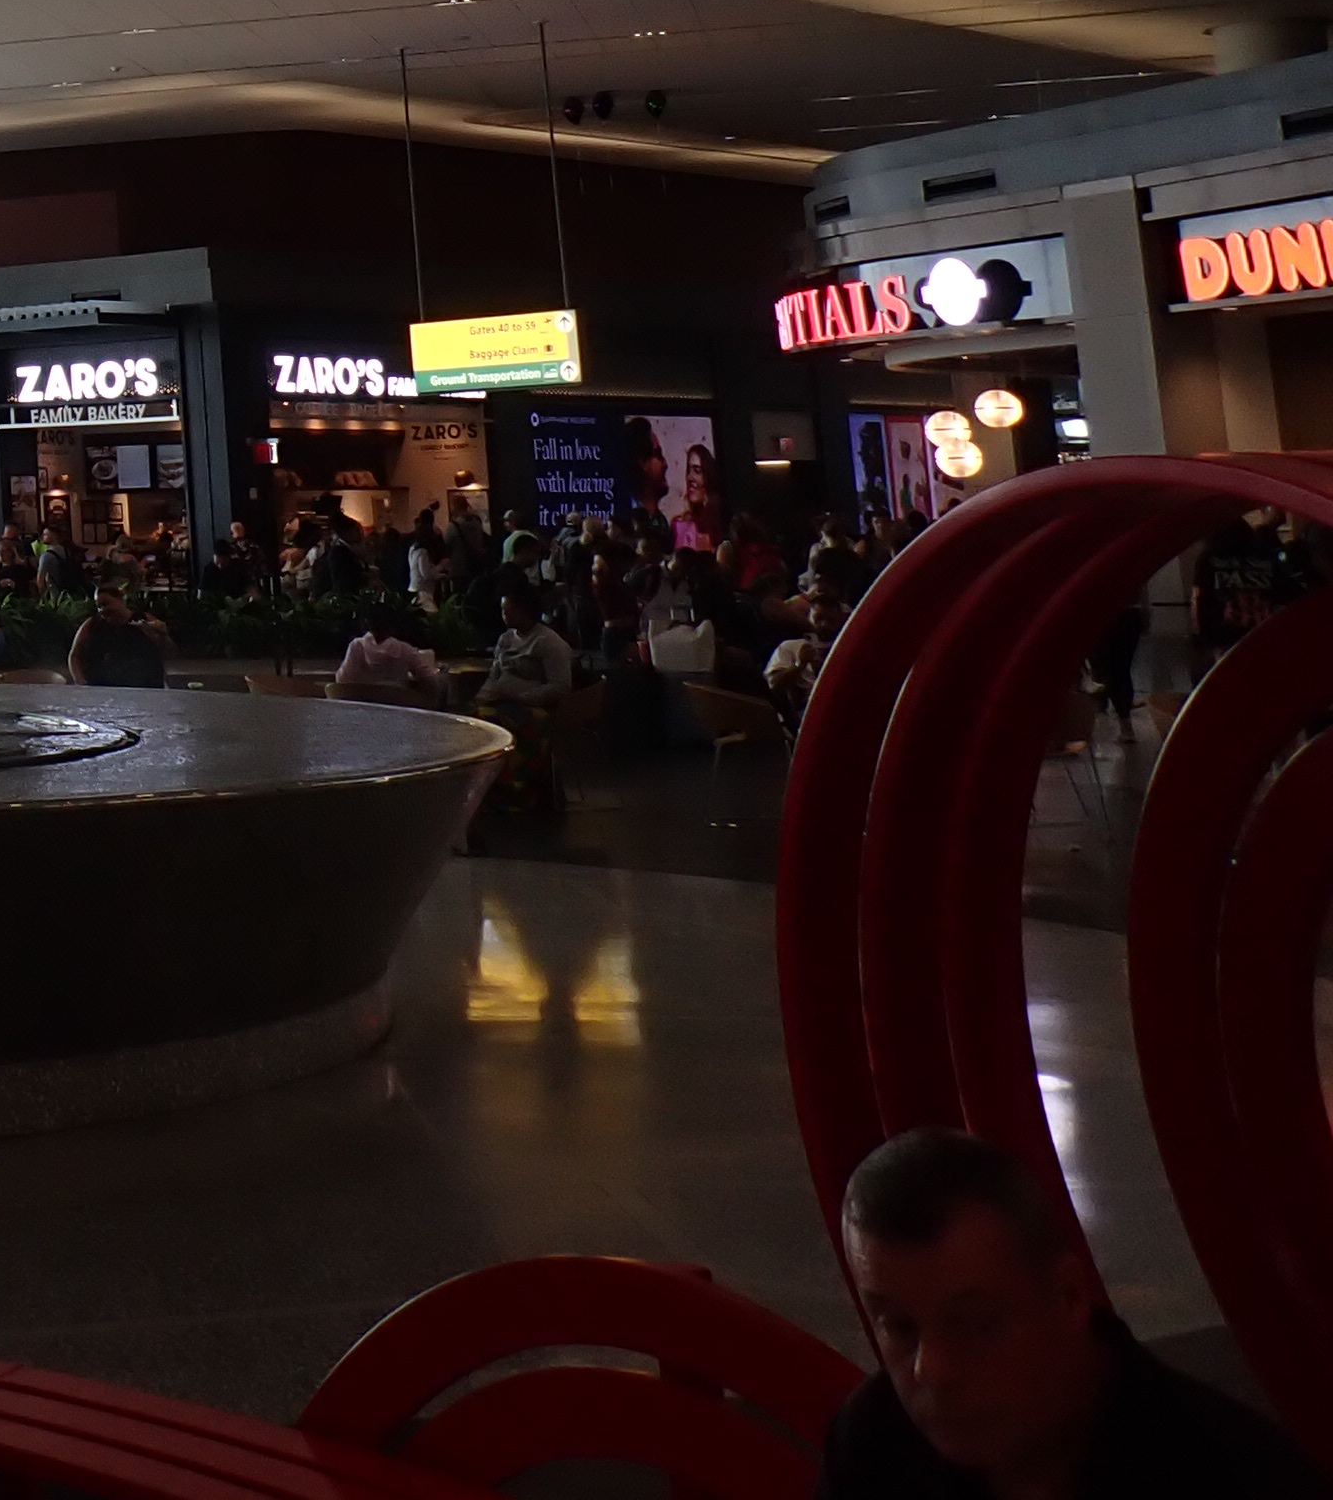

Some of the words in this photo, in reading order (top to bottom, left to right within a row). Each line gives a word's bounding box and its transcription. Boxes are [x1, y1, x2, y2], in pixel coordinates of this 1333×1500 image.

[1179, 219, 1333, 301] DUN
[469, 324, 496, 336] Gates
[498, 322, 510, 333] 40
[512, 322, 522, 332] to
[469, 348, 509, 360] Baggage
[512, 345, 539, 357] Claim
[16, 357, 158, 402] ZARO'S
[273, 354, 385, 397] ZARO'S
[387, 376, 419, 397] FAM
[429, 372, 466, 386] Ground
[467, 368, 541, 385] Transportation
[30, 404, 84, 424] FAMILY
[88, 402, 146, 421] BAKERY
[37, 429, 76, 446] ARO'S
[411, 423, 477, 441] ZARO'S
[533, 437, 558, 461] Fall
[560, 439, 573, 461] in
[575, 438, 601, 461] love
[535, 470, 566, 493] with
[569, 470, 615, 500] leaving
[538, 504, 549, 527] it
